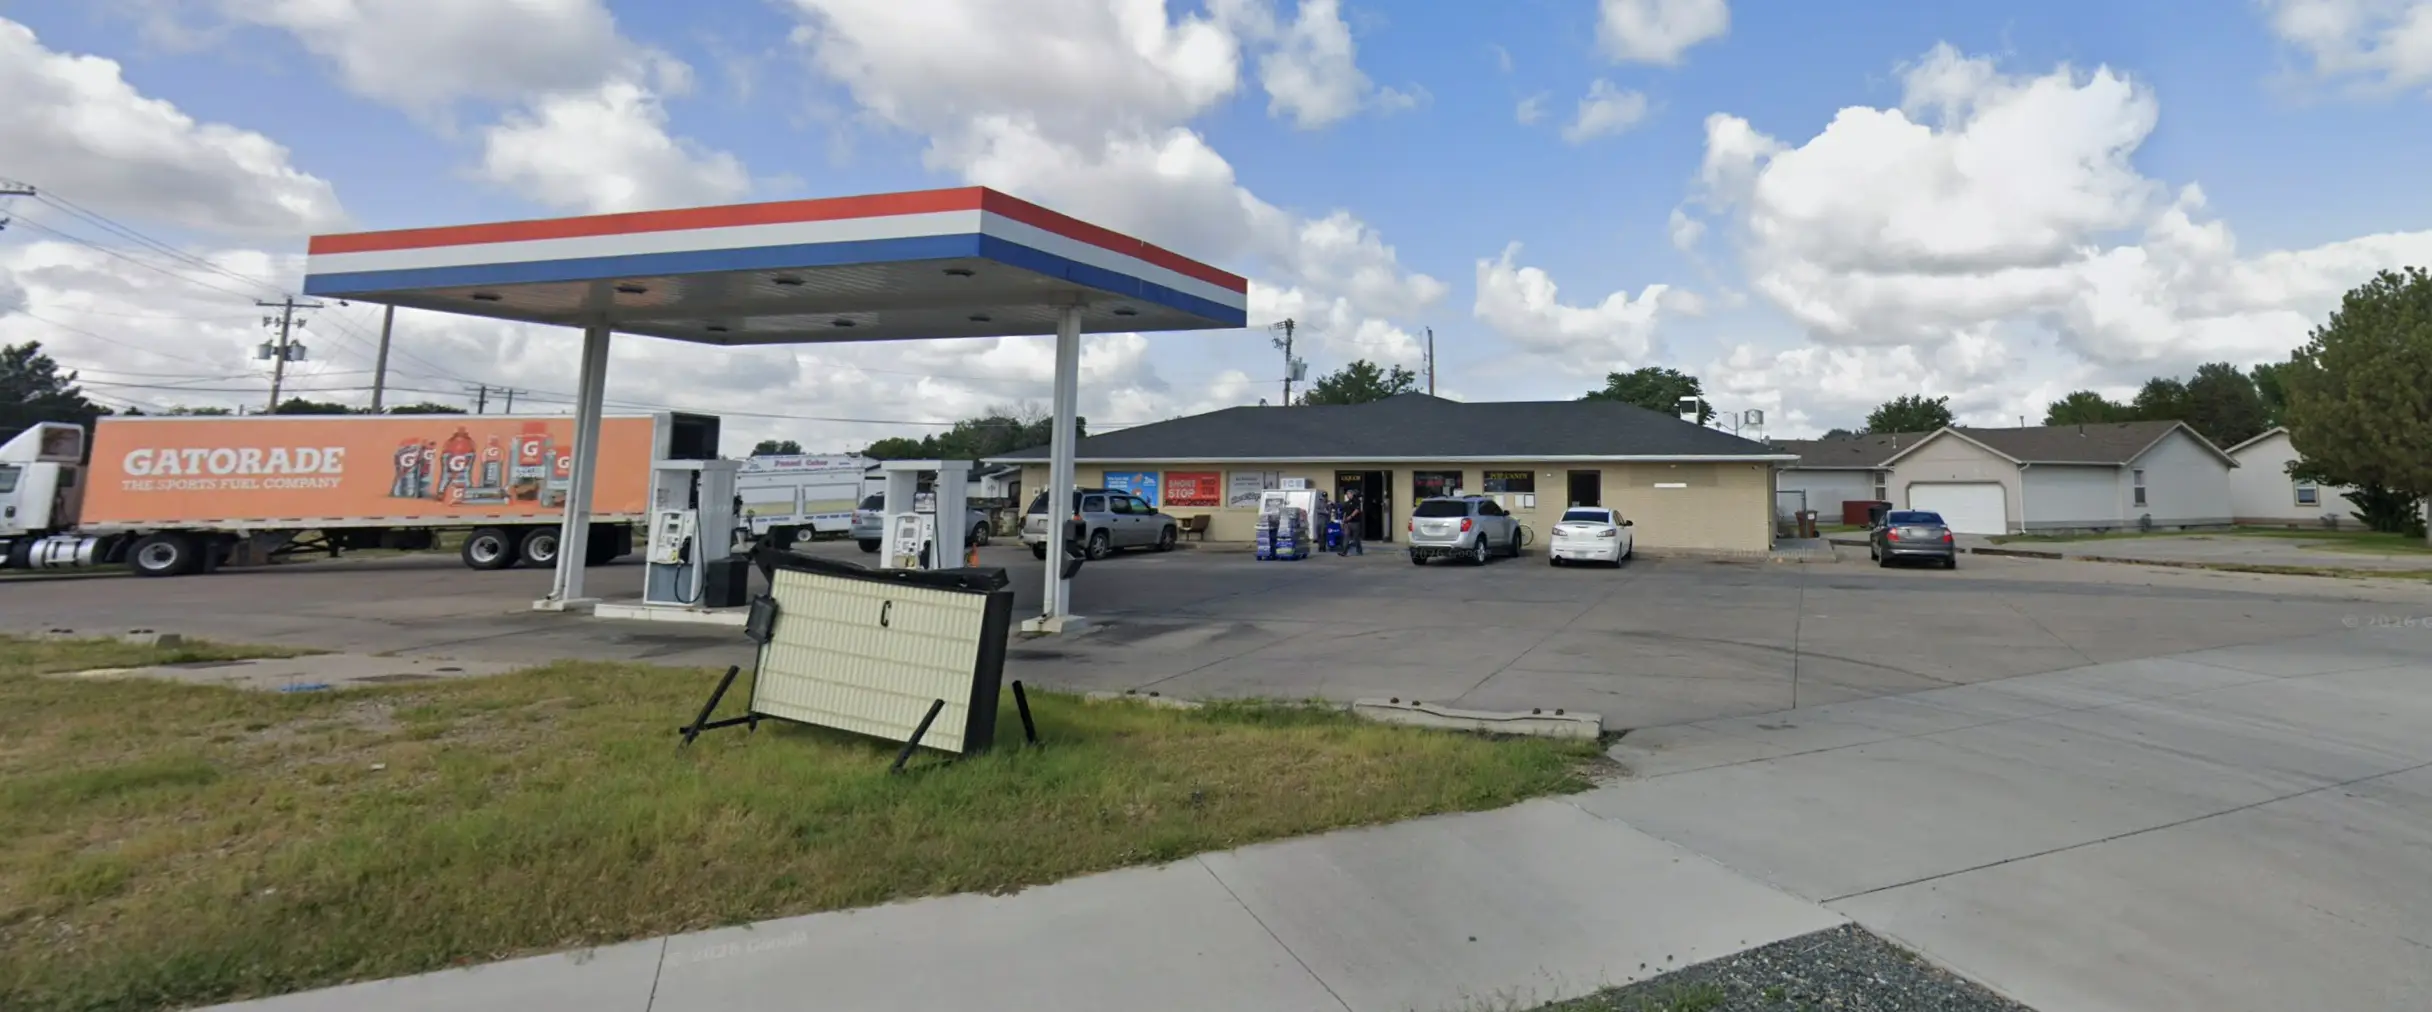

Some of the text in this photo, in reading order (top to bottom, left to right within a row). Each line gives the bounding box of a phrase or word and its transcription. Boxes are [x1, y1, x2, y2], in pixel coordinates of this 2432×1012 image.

[424, 449, 435, 460] G
[488, 447, 498, 456] G
[523, 441, 538, 456] G
[123, 447, 345, 475] GATORADE
[401, 452, 417, 467] G
[450, 455, 466, 471] G
[557, 456, 570, 468] G
[122, 477, 341, 490] THE SPORTS FUEL COMPANY
[1168, 489, 1196, 499] STOP
[880, 600, 892, 628] C
